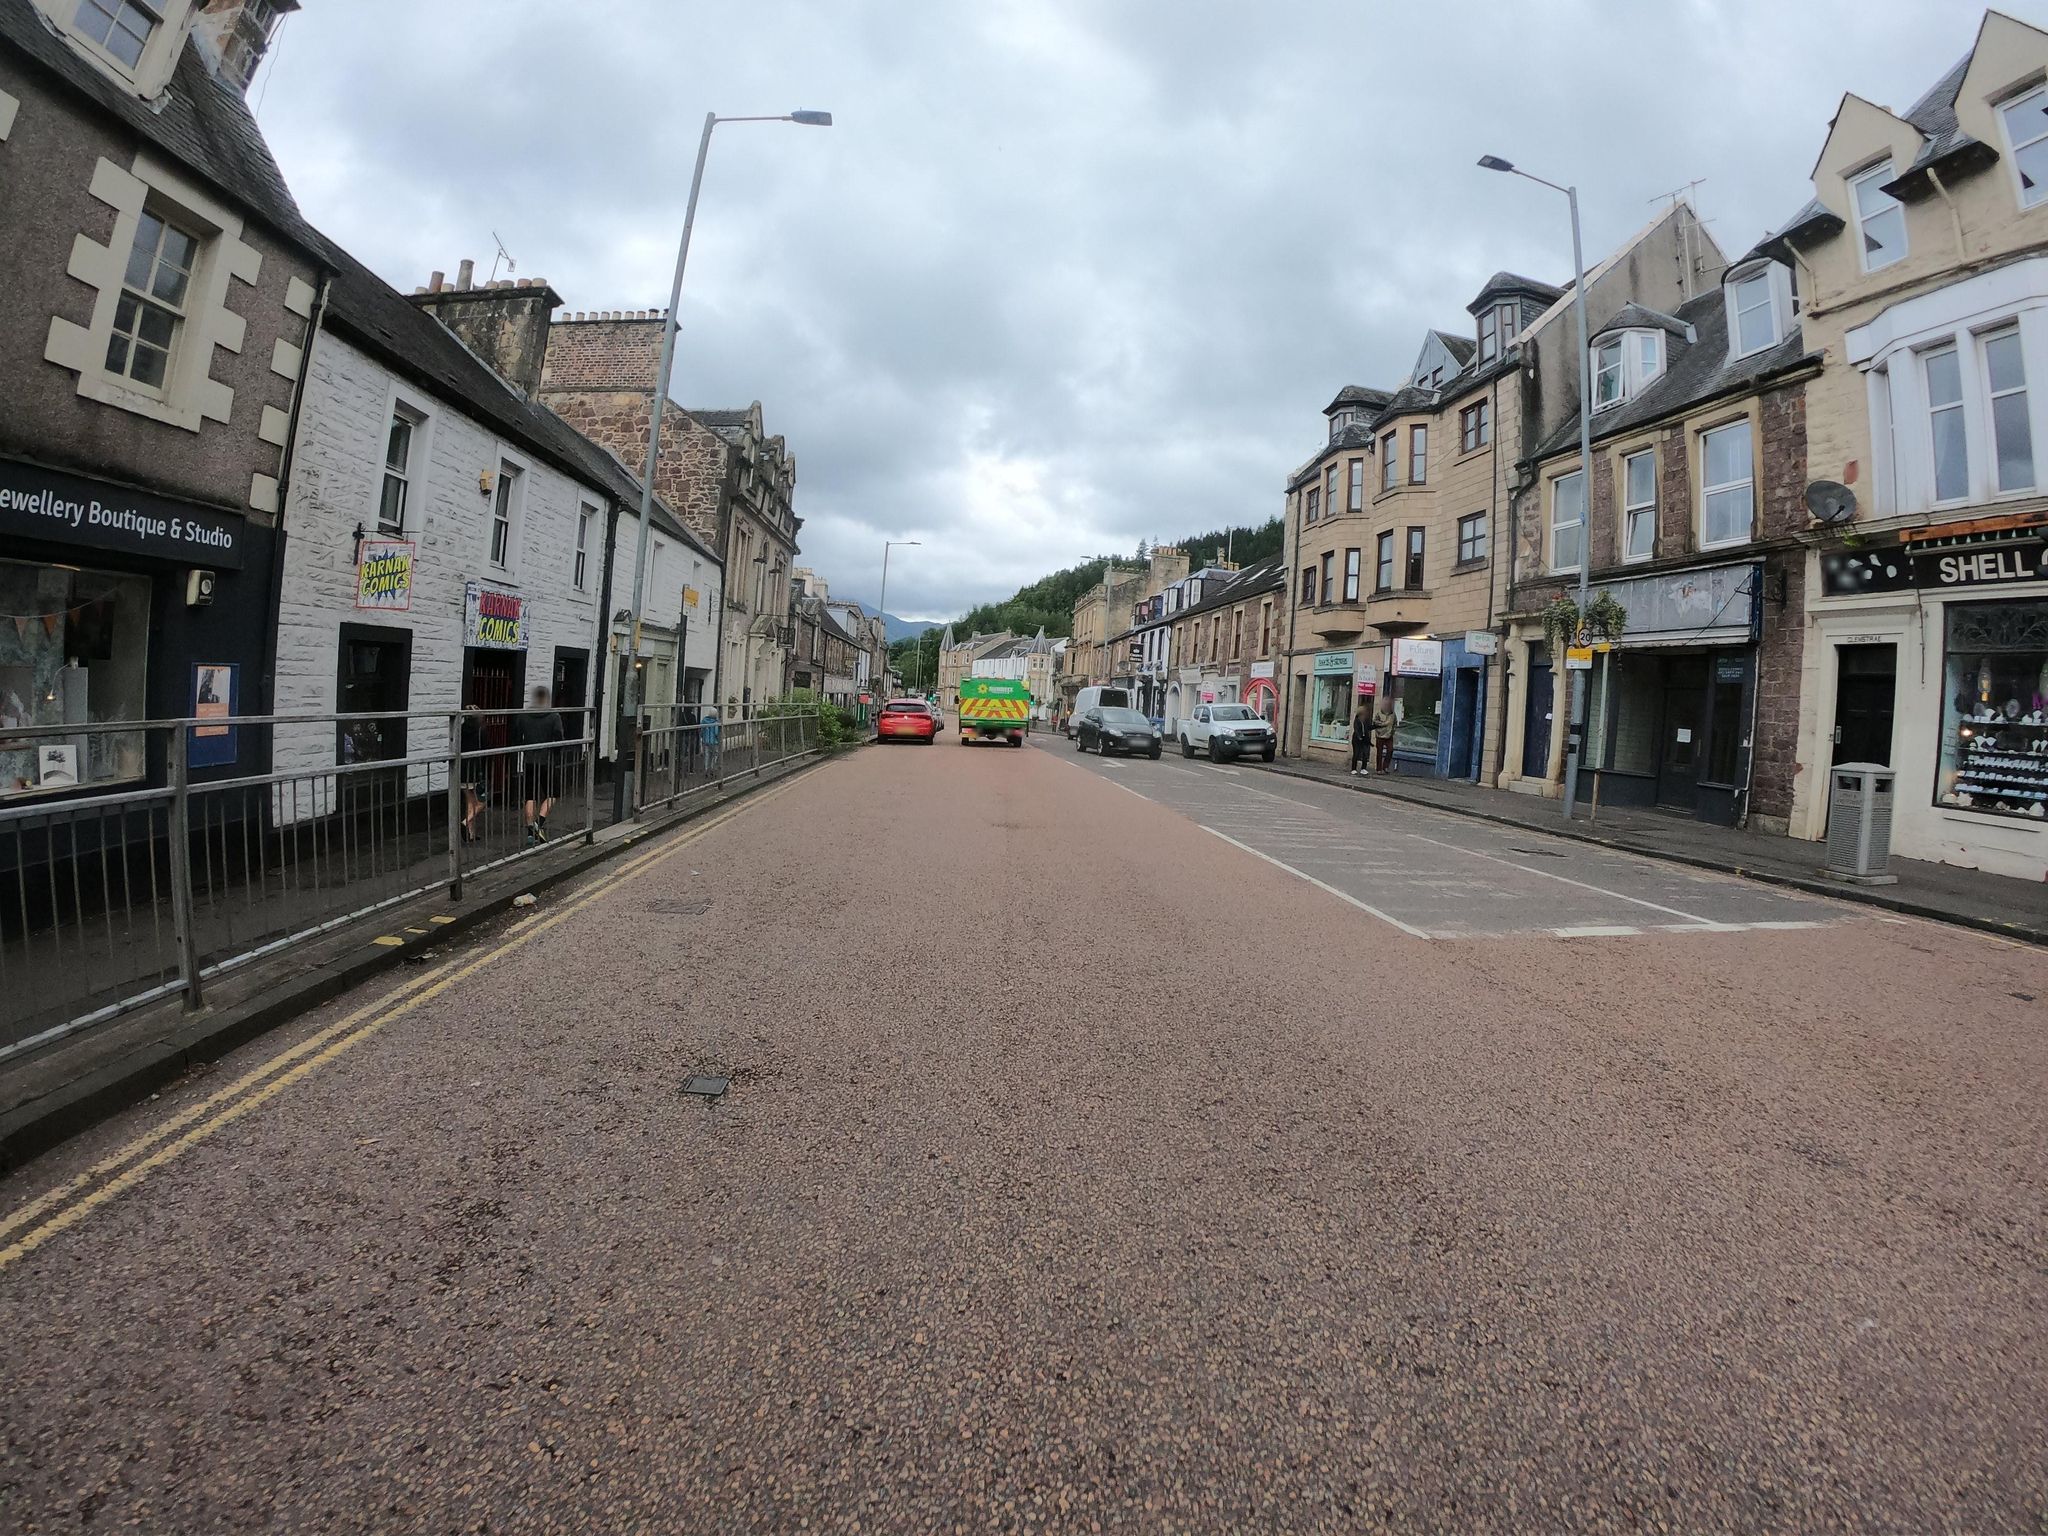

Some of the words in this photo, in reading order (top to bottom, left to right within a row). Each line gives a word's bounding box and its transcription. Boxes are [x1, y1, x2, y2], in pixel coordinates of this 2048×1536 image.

[0, 488, 85, 527] ewellery
[88, 500, 167, 540] Boutique
[170, 518, 182, 539] &
[185, 521, 233, 549] Studio
[360, 553, 411, 579] KARNAK
[1940, 551, 2034, 583] SHELL
[361, 569, 410, 597] COMICS
[479, 591, 522, 620] KARNAK
[478, 617, 520, 644] COMICS
[1580, 632, 1591, 642] 20
